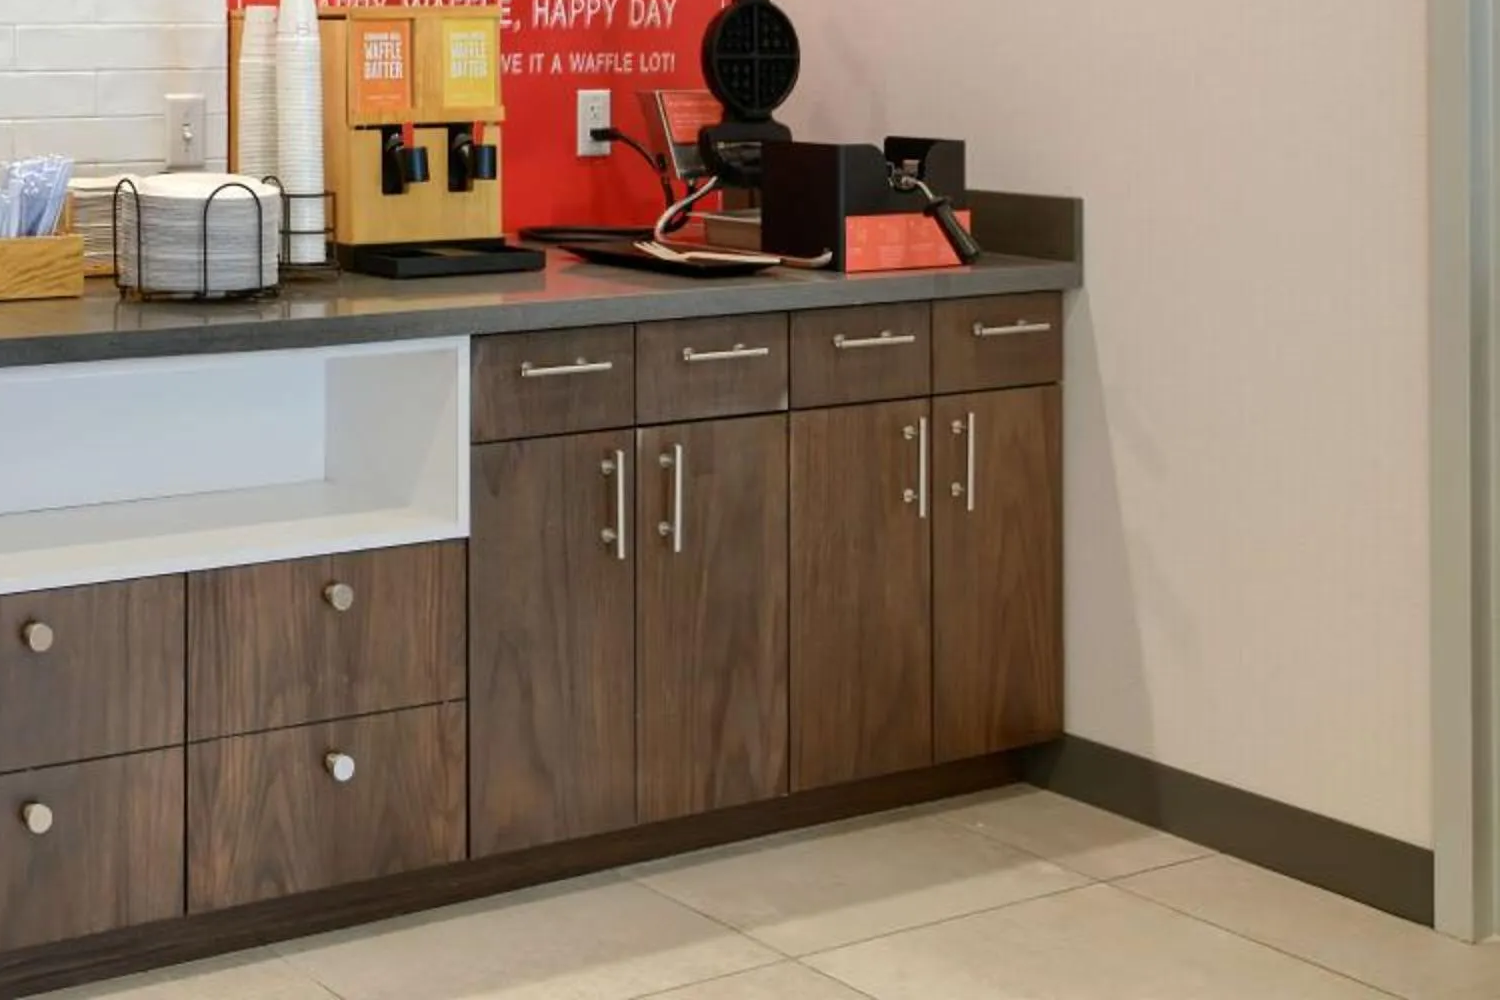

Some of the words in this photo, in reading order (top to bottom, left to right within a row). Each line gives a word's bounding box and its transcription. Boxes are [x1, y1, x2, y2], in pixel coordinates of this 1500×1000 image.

[500, 53, 522, 74] VE
[529, 53, 545, 74] IT
[551, 52, 562, 74] A
[569, 53, 632, 74] WAFFLE
[640, 53, 675, 74] LOT!
